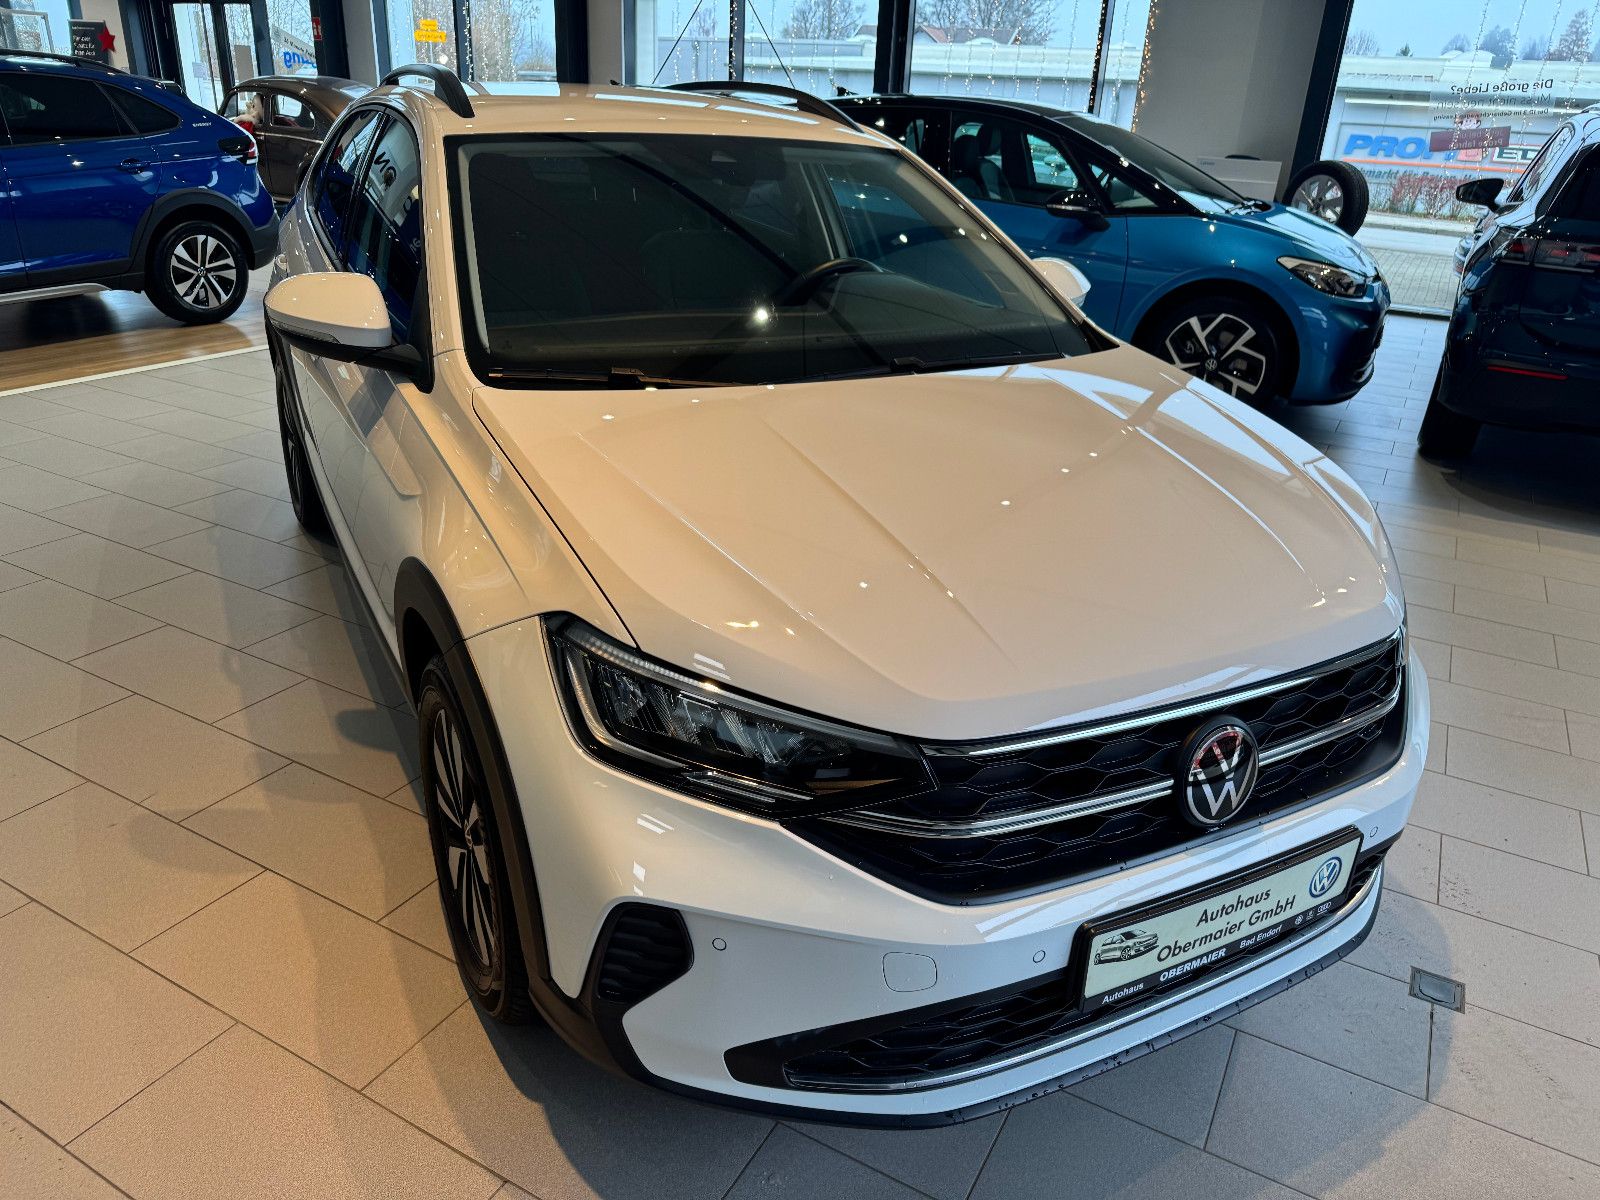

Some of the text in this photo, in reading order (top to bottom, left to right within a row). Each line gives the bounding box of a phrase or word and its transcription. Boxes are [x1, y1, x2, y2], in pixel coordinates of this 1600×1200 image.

[1156, 895, 1297, 963] Obermaier GmbH
[1195, 888, 1271, 928] Autohaus
[1101, 924, 1282, 1005] Autohaus OBERMAIER Bad Endorf
